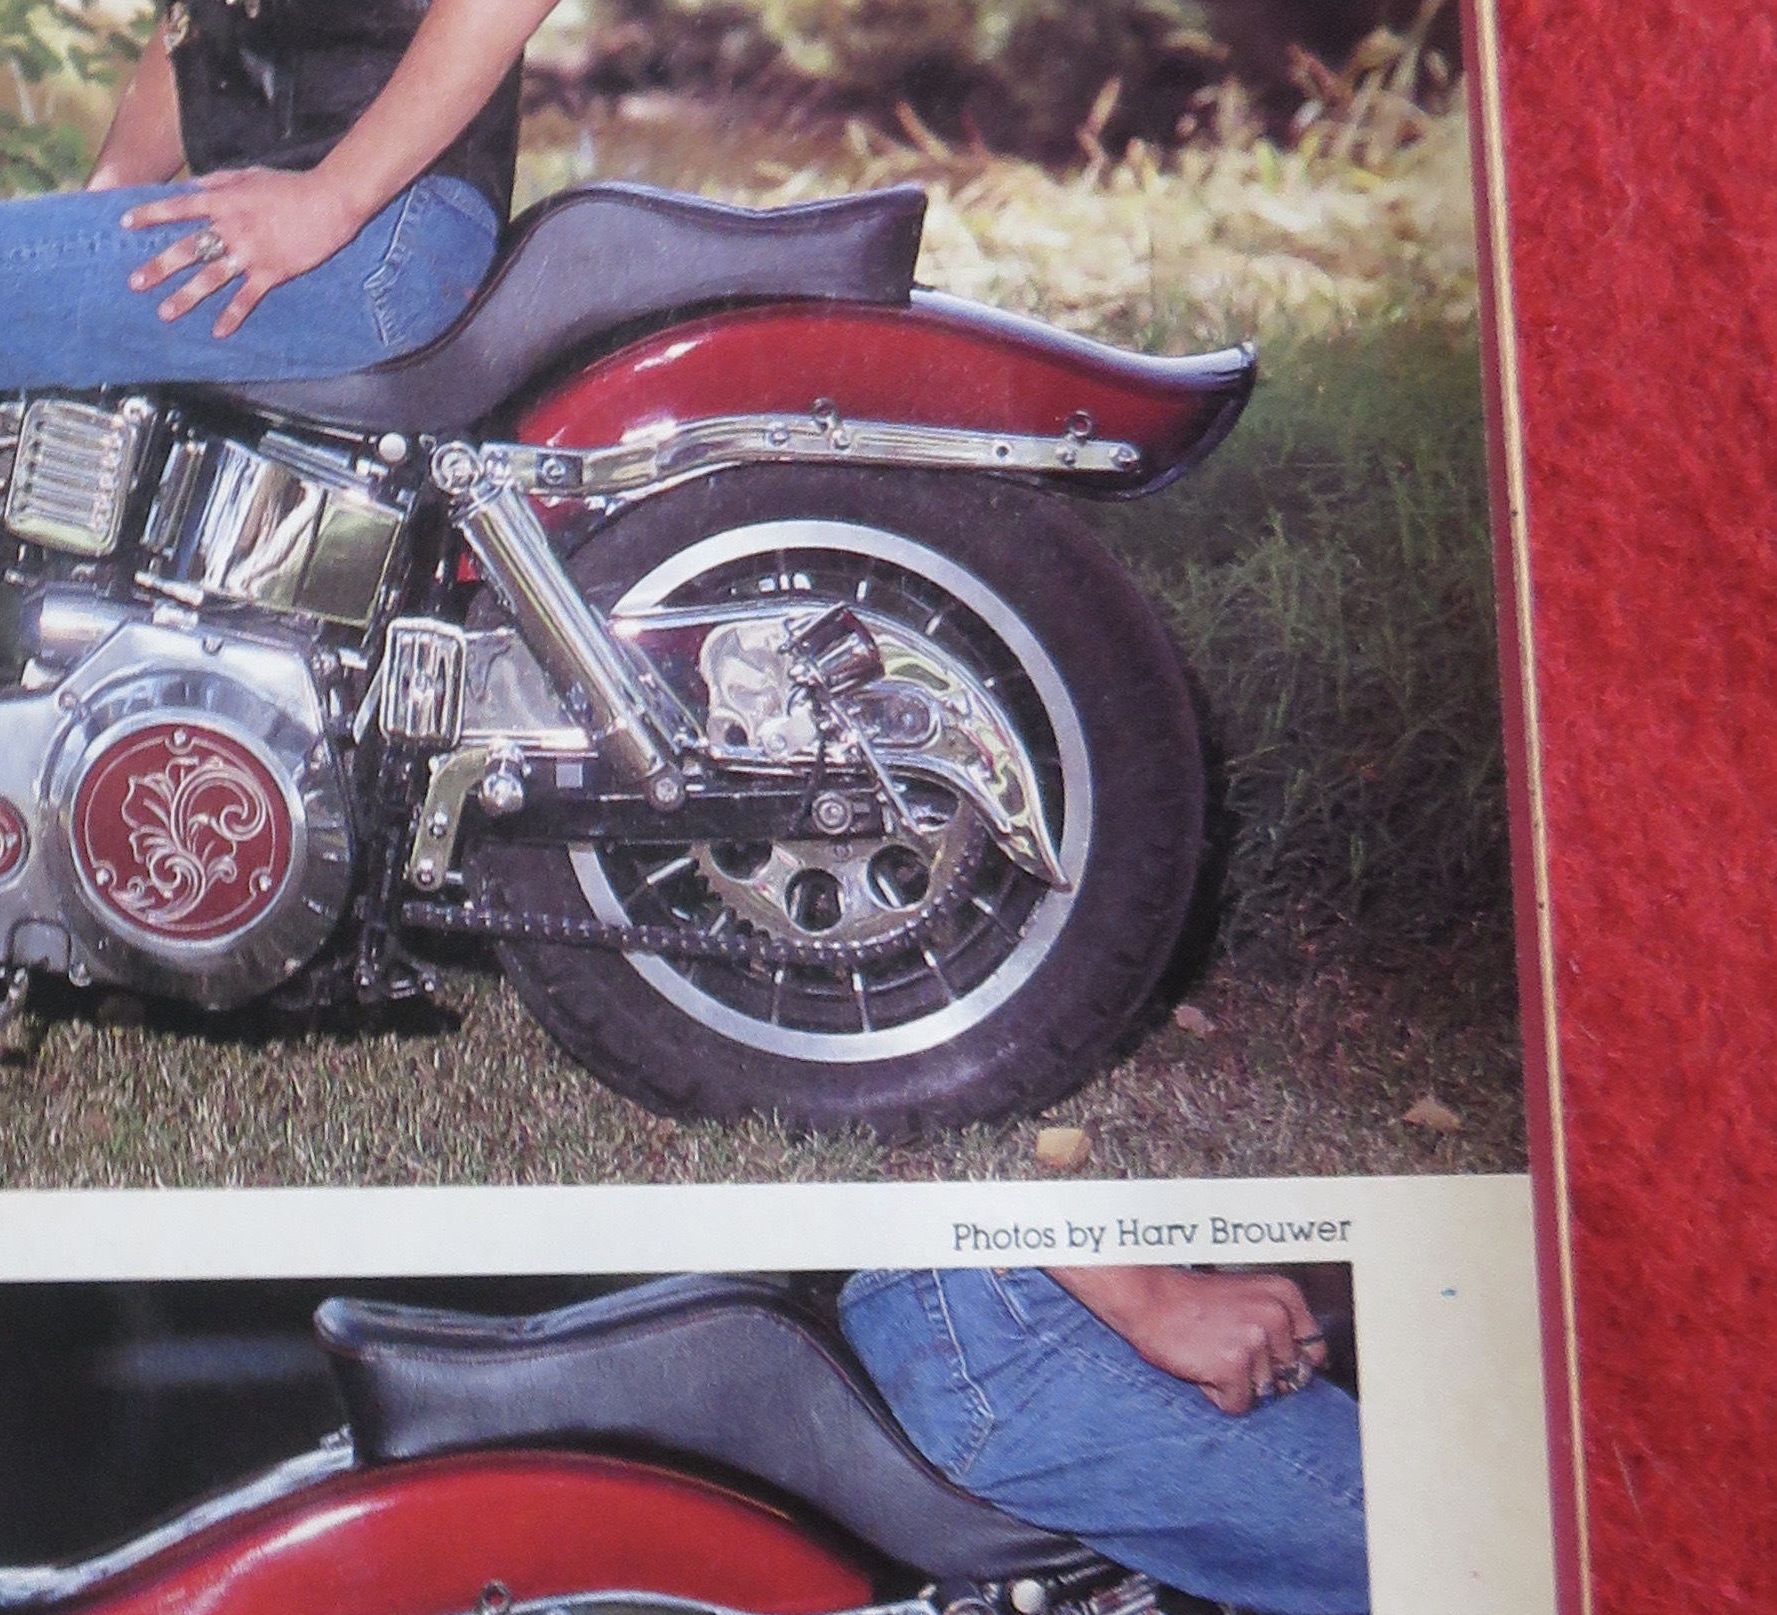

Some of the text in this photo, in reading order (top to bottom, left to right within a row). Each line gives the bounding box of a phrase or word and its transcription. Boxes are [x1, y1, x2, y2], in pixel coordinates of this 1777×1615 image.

[952, 1216, 1352, 1253] Photos by Harv Brouwer
